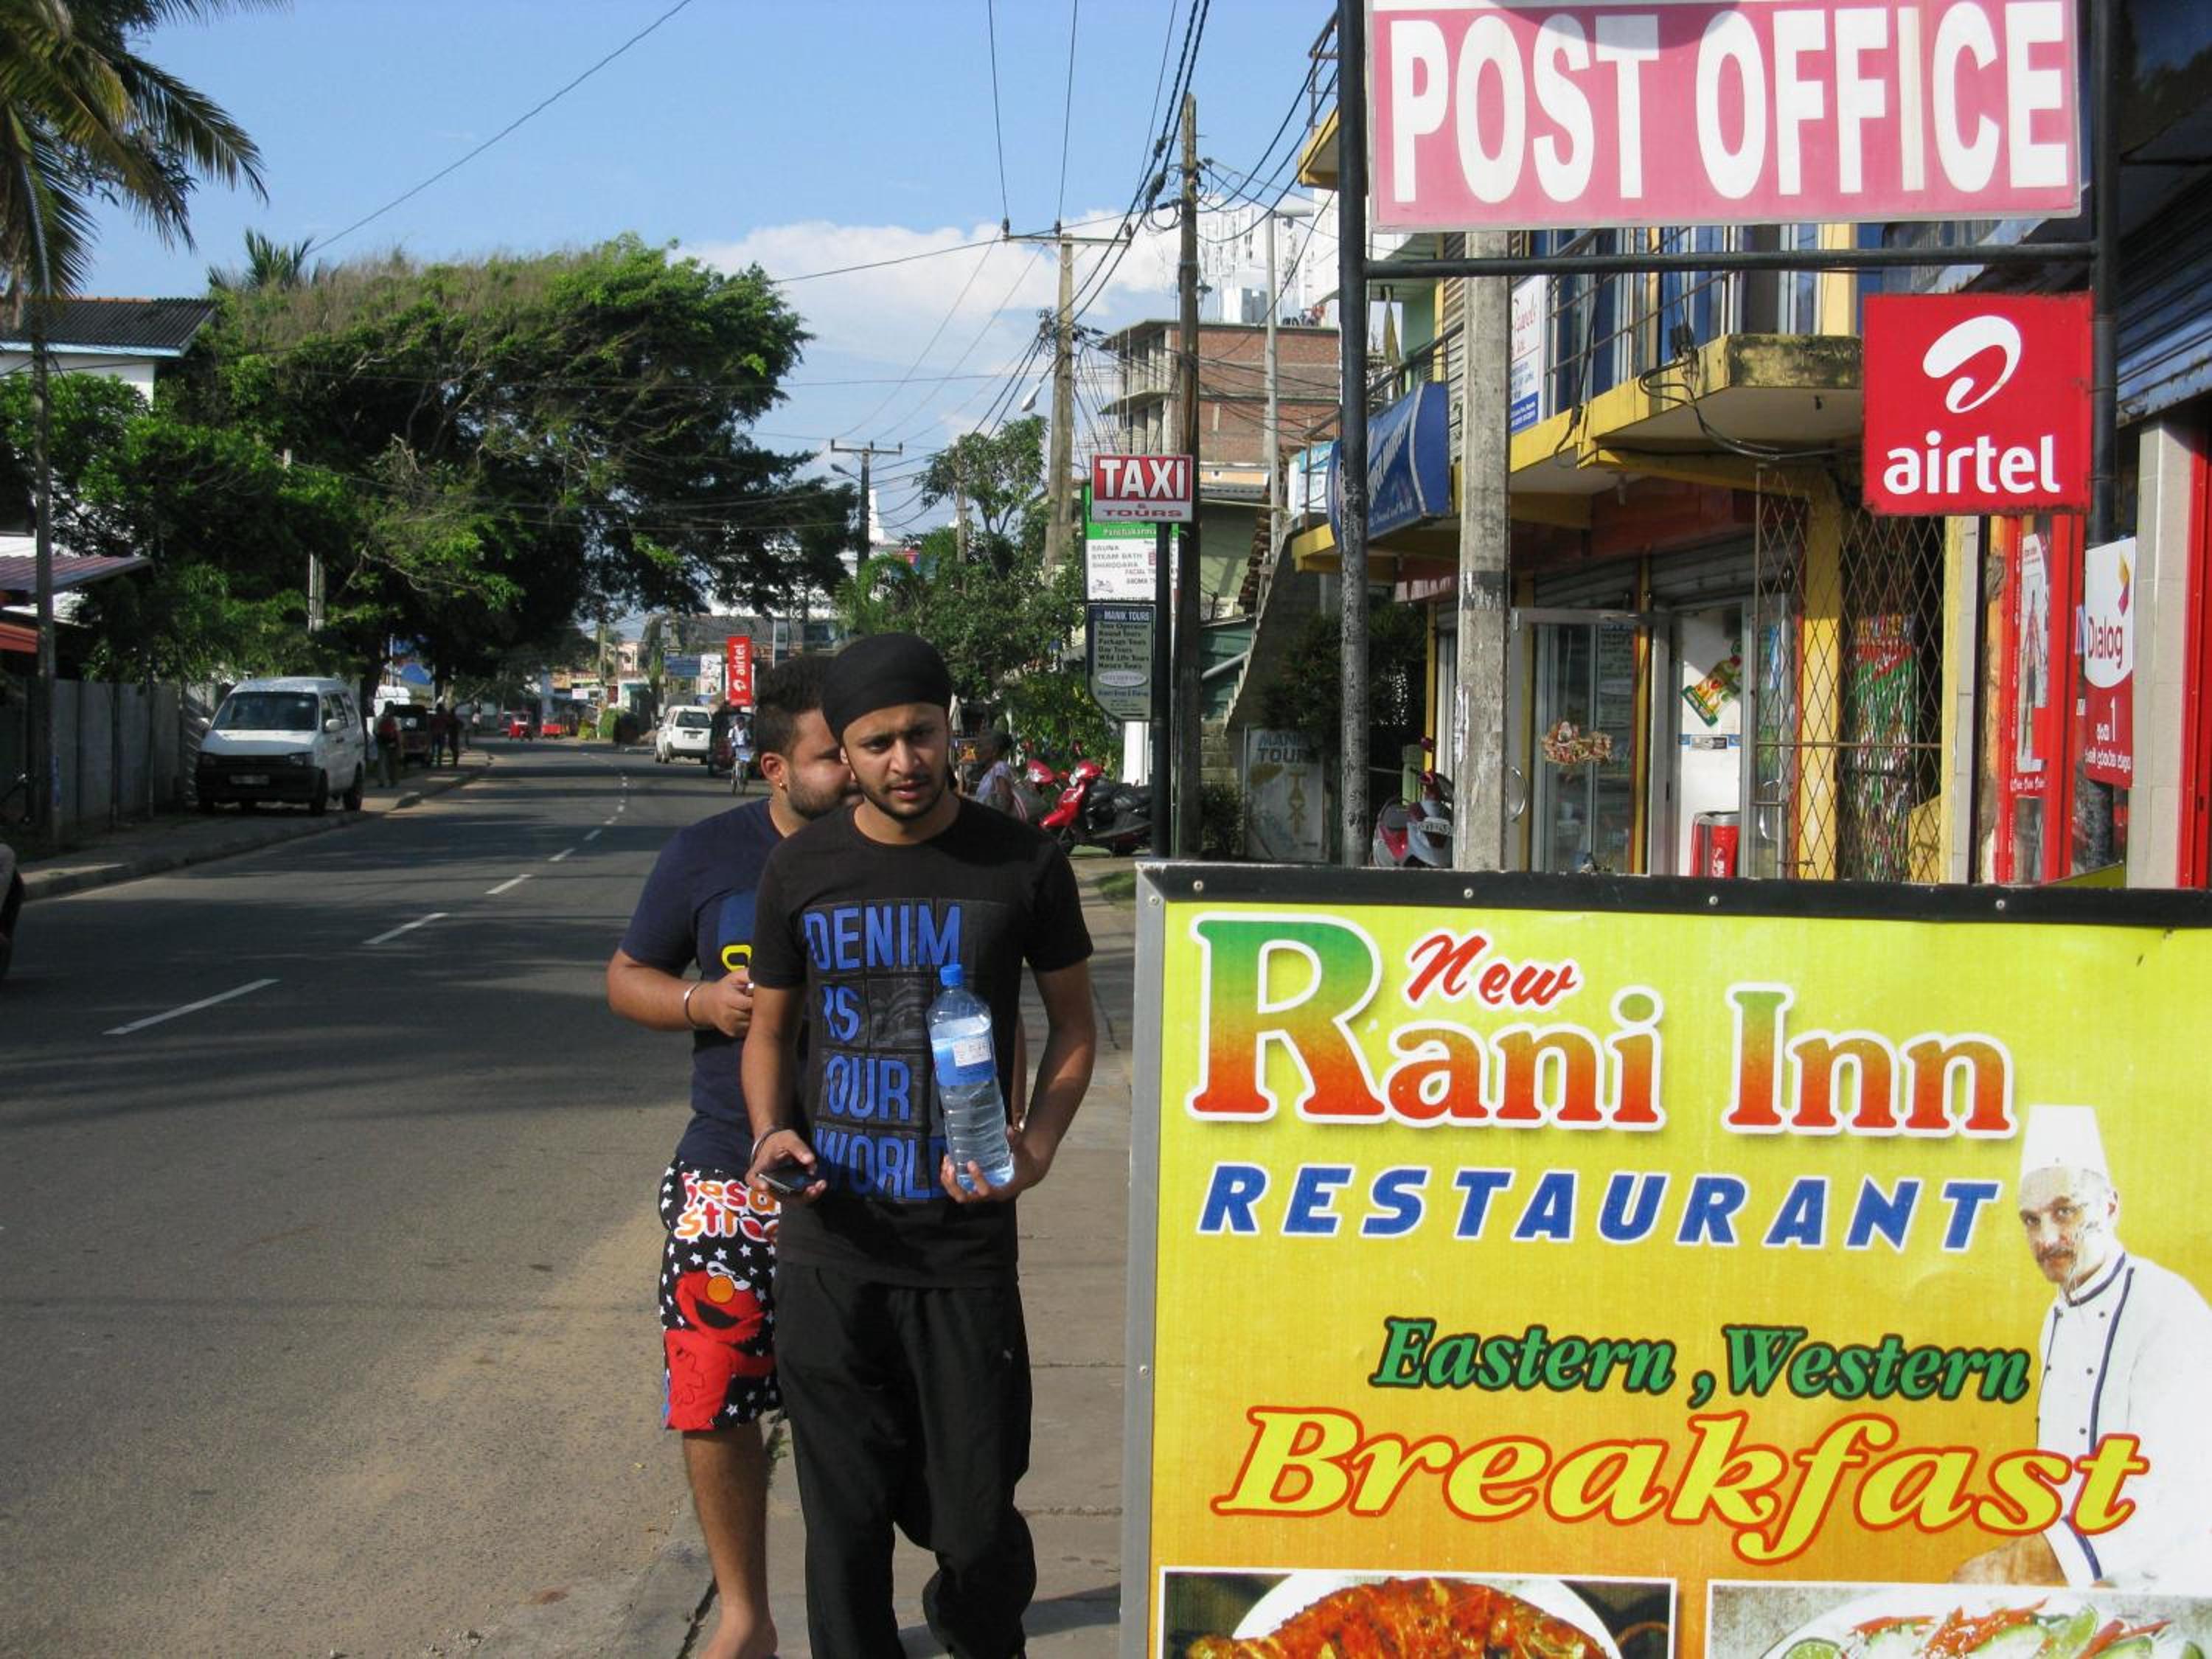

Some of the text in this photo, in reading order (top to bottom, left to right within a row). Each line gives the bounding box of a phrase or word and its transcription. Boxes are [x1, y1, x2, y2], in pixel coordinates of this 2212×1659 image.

[1391, 1, 2067, 204] POST OFFICE
[1099, 459, 1185, 499] TAXI
[1883, 429, 2060, 495] airtel
[1102, 508, 1183, 517] TOURS
[1128, 611, 1150, 621] TOURS
[2087, 616, 2124, 669] Dialog
[734, 644, 746, 676] airtel
[803, 904, 961, 971] DENIM
[1399, 929, 1582, 1010] New
[823, 984, 860, 1042] IS
[1186, 912, 2018, 1139] Rani Inn
[827, 1054, 911, 1121] OUR
[1196, 1161, 2003, 1254] RESTAURANT
[1368, 1316, 1675, 1399] Eastern
[1211, 1405, 2151, 1567] Breakfast
